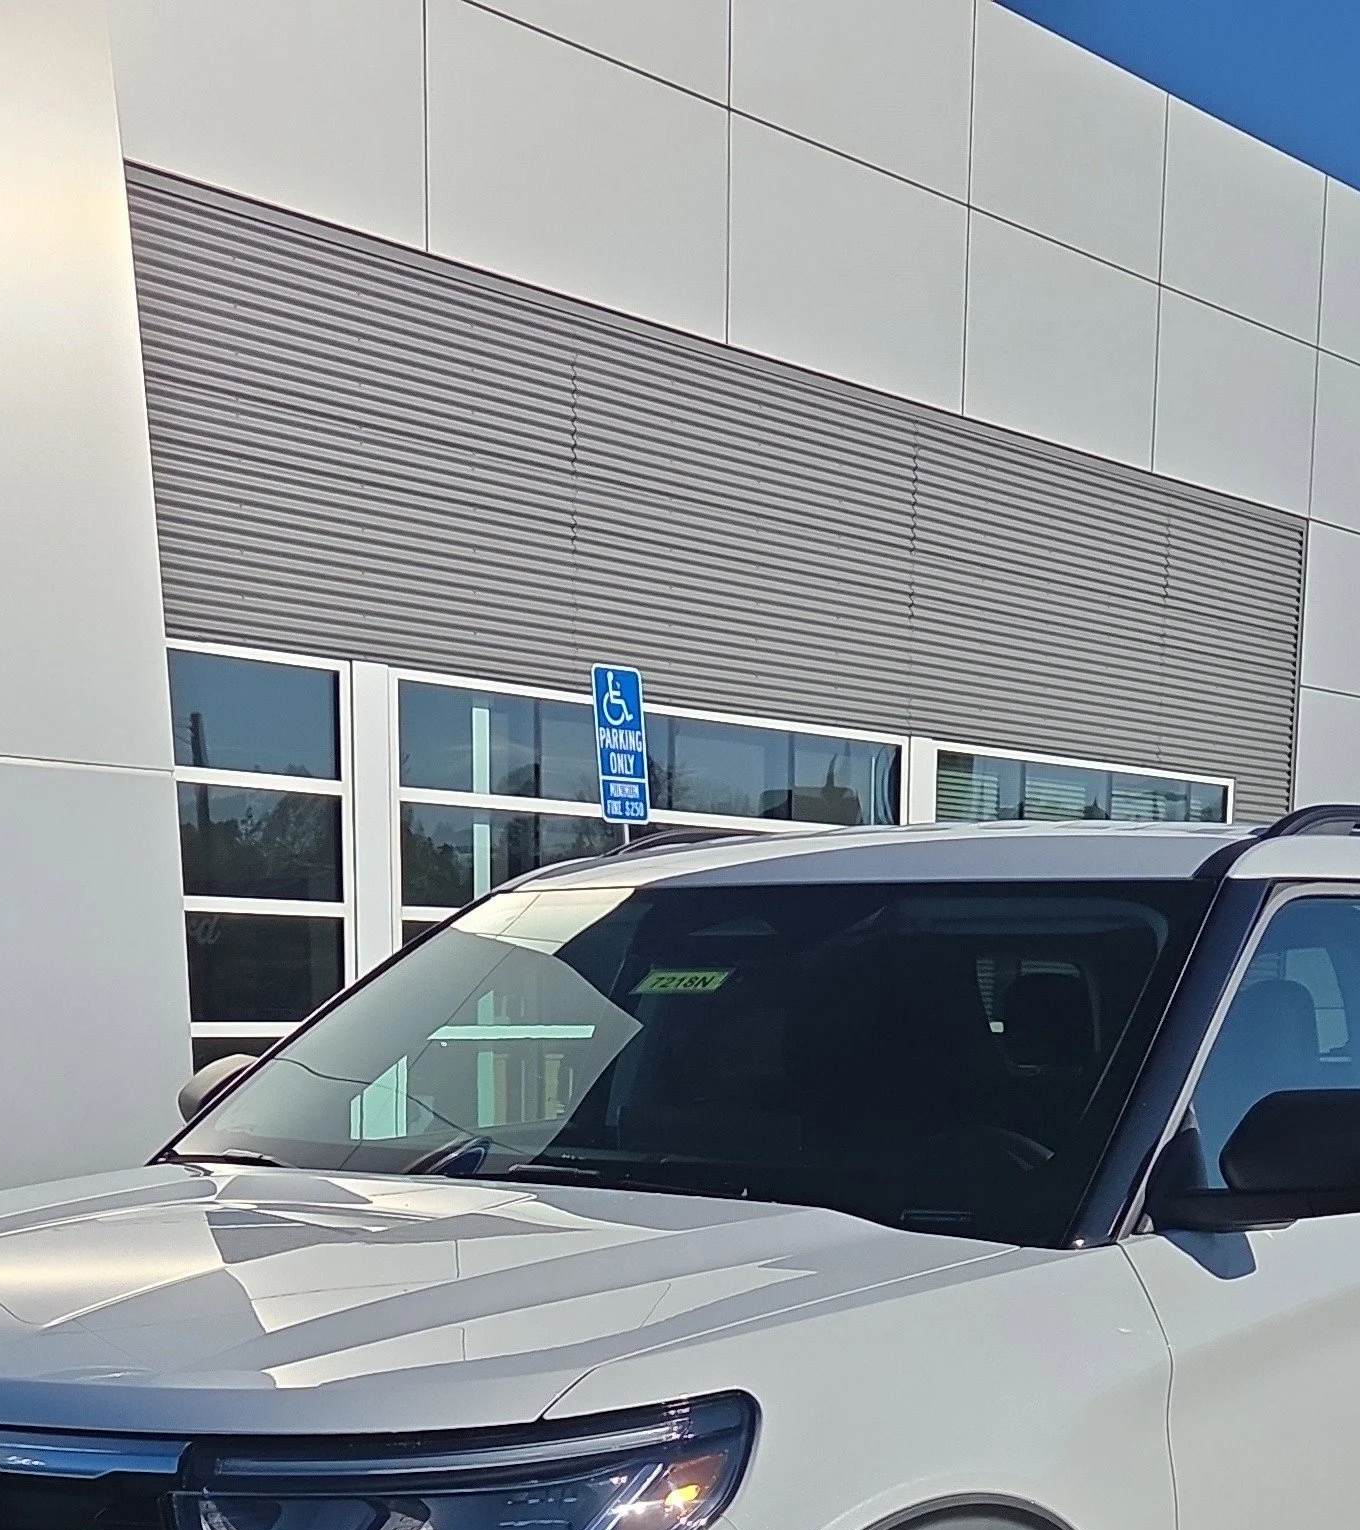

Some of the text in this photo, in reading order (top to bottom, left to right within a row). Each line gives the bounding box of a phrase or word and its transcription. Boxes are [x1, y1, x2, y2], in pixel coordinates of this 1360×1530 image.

[599, 726, 643, 753] PARKING
[609, 751, 635, 775] ONLY
[648, 975, 715, 989] 7218N
